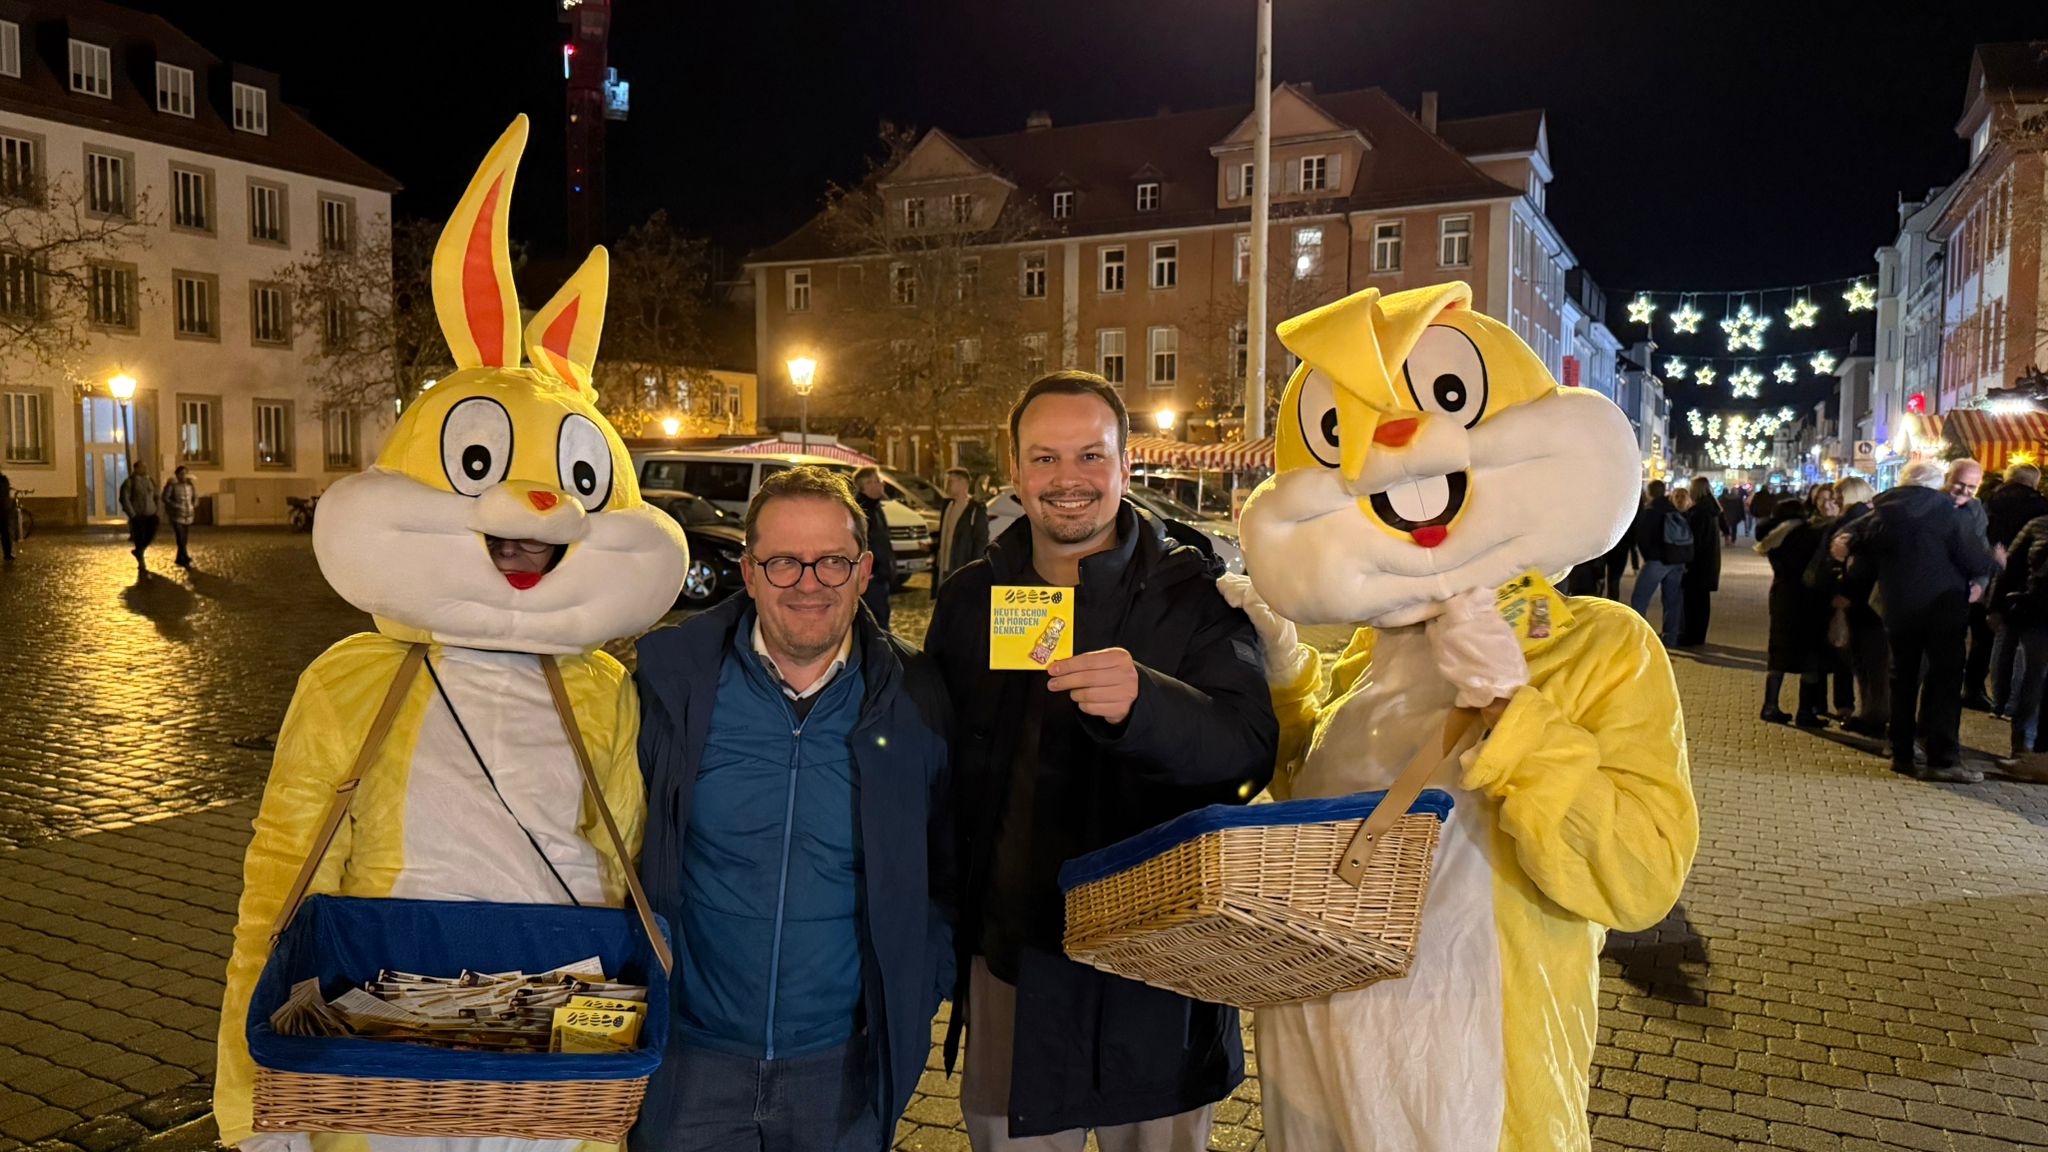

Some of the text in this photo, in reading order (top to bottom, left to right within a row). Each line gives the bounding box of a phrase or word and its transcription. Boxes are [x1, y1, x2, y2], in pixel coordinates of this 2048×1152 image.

[994, 608, 1047, 617] HEUTE SCHON
[994, 617, 1039, 626] AN MORGEN
[994, 626, 1025, 634] DENKEN
